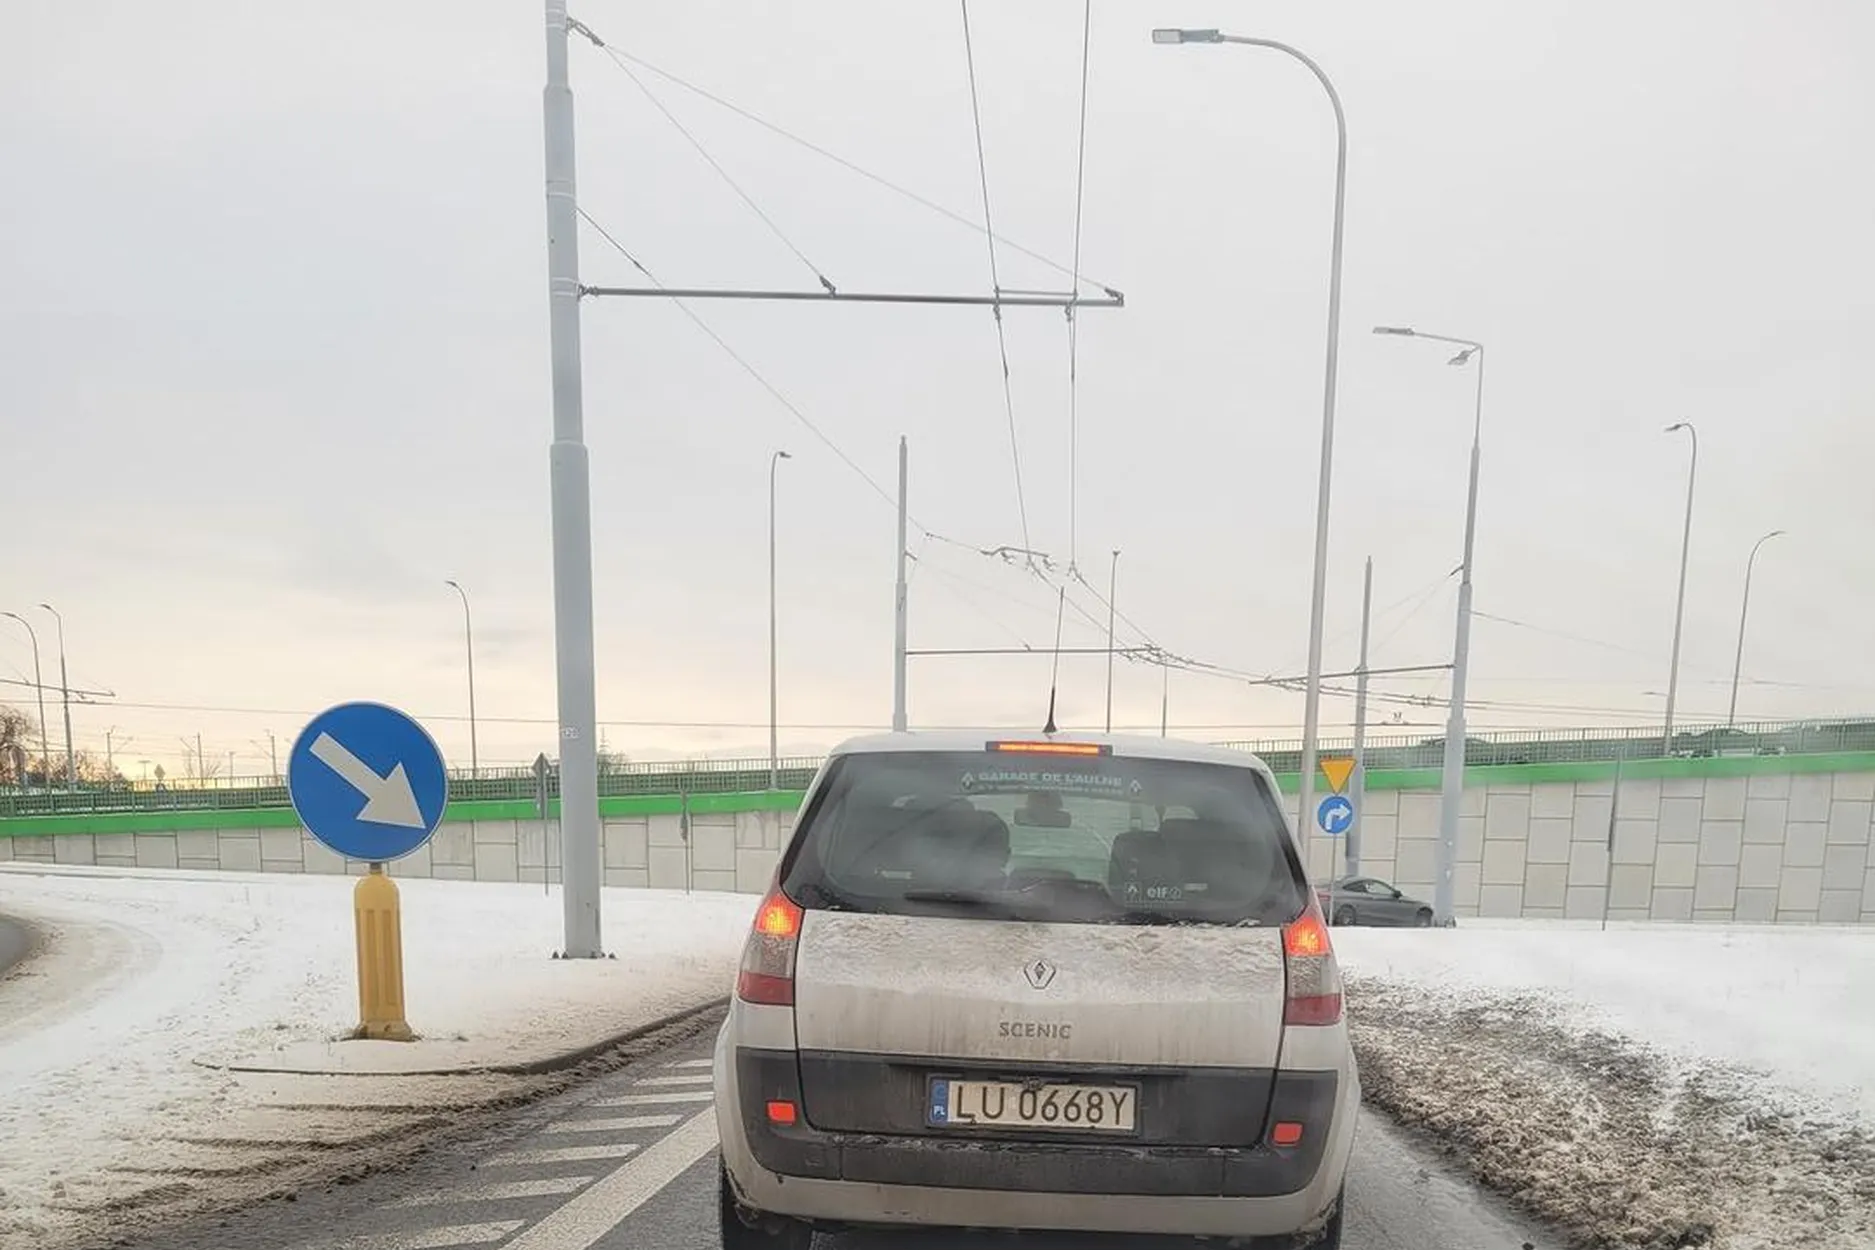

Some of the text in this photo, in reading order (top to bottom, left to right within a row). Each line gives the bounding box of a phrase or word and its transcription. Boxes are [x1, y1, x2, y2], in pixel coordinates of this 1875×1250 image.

[1042, 773, 1061, 782] DE
[999, 1022, 1072, 1039] SCENIC
[933, 1106, 945, 1116] PL
[957, 1085, 1128, 1125] LU 0668Y
